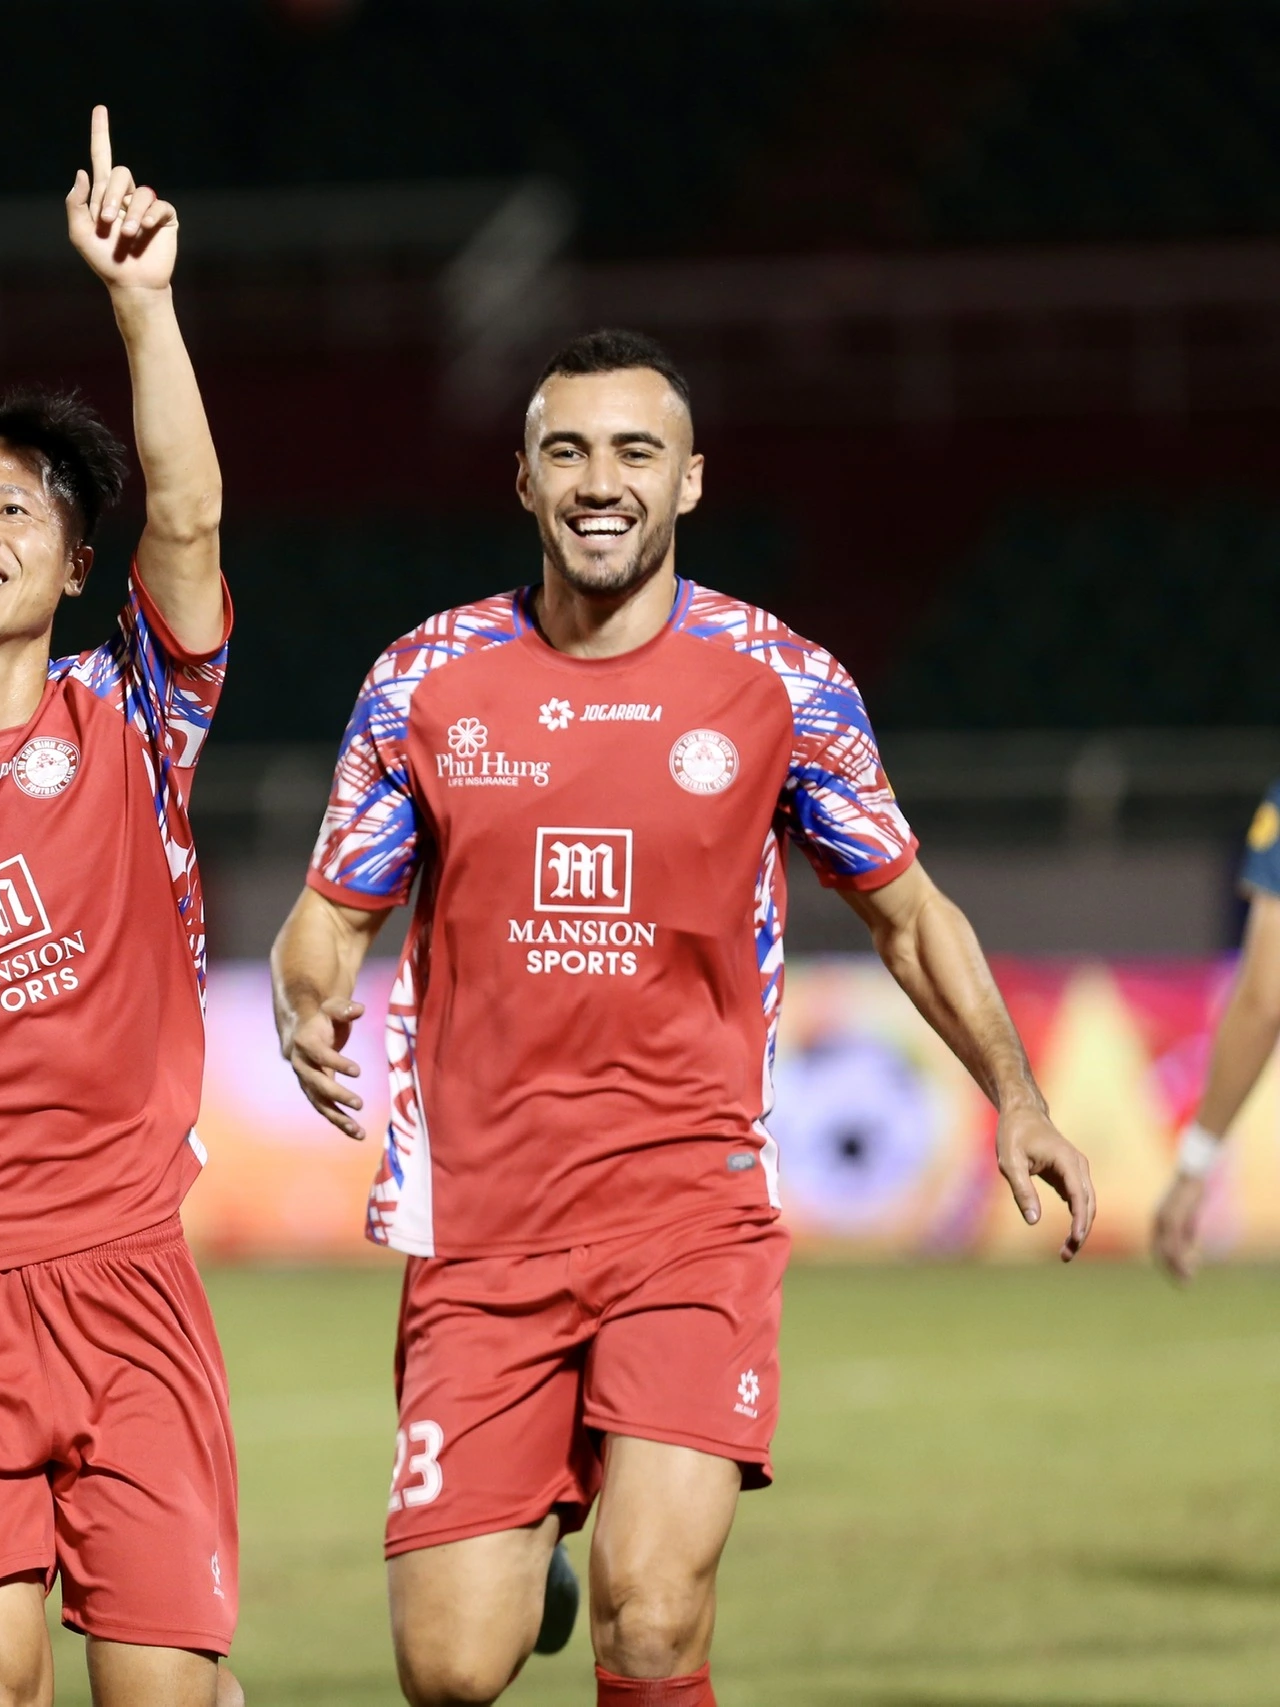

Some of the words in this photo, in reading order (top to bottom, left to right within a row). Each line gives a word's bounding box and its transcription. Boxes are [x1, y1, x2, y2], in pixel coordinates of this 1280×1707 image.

[579, 703, 663, 722] JOGARBOLA
[435, 752, 475, 779] Phu
[481, 750, 552, 787] Hung
[447, 777, 464, 788] LIFE
[464, 775, 519, 788] INSURANCE
[548, 840, 619, 900] M
[507, 919, 657, 947] MANSION
[526, 949, 638, 976] SPORTS
